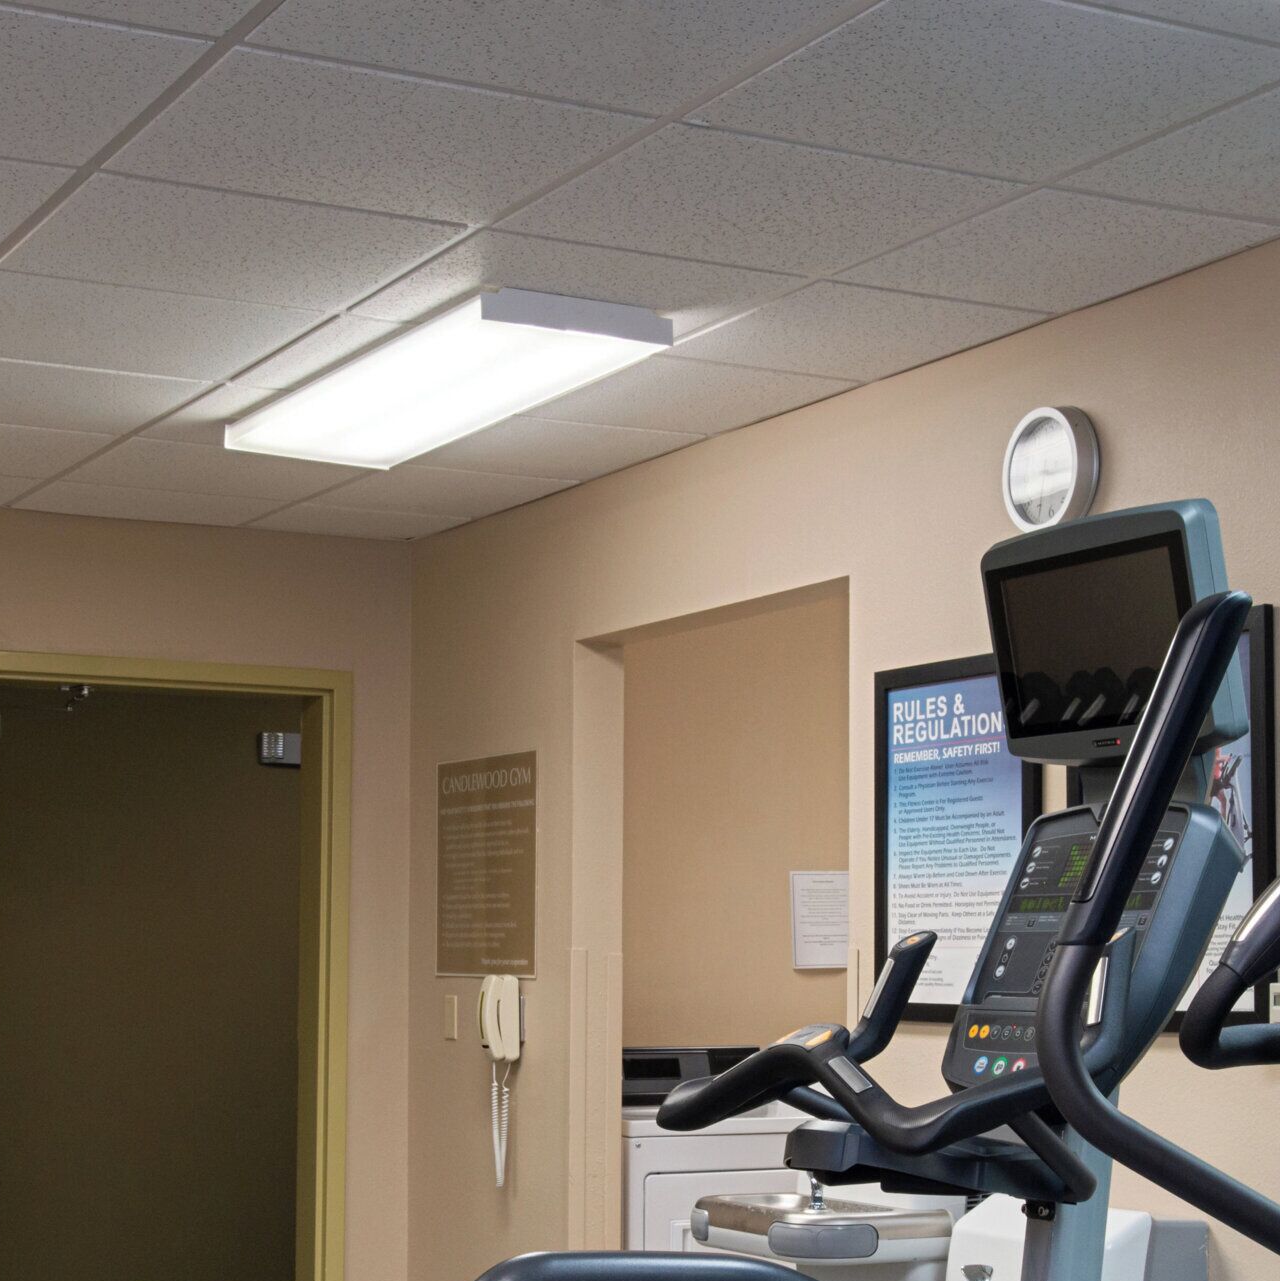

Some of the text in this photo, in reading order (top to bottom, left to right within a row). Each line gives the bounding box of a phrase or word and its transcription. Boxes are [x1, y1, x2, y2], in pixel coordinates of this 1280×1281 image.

[893, 693, 965, 723] RULES &
[893, 711, 1005, 745] REGULATION
[894, 741, 1000, 764] REMEMBER, SAFETY FIRST!
[442, 767, 531, 794] CANDLEWOOD GYM
